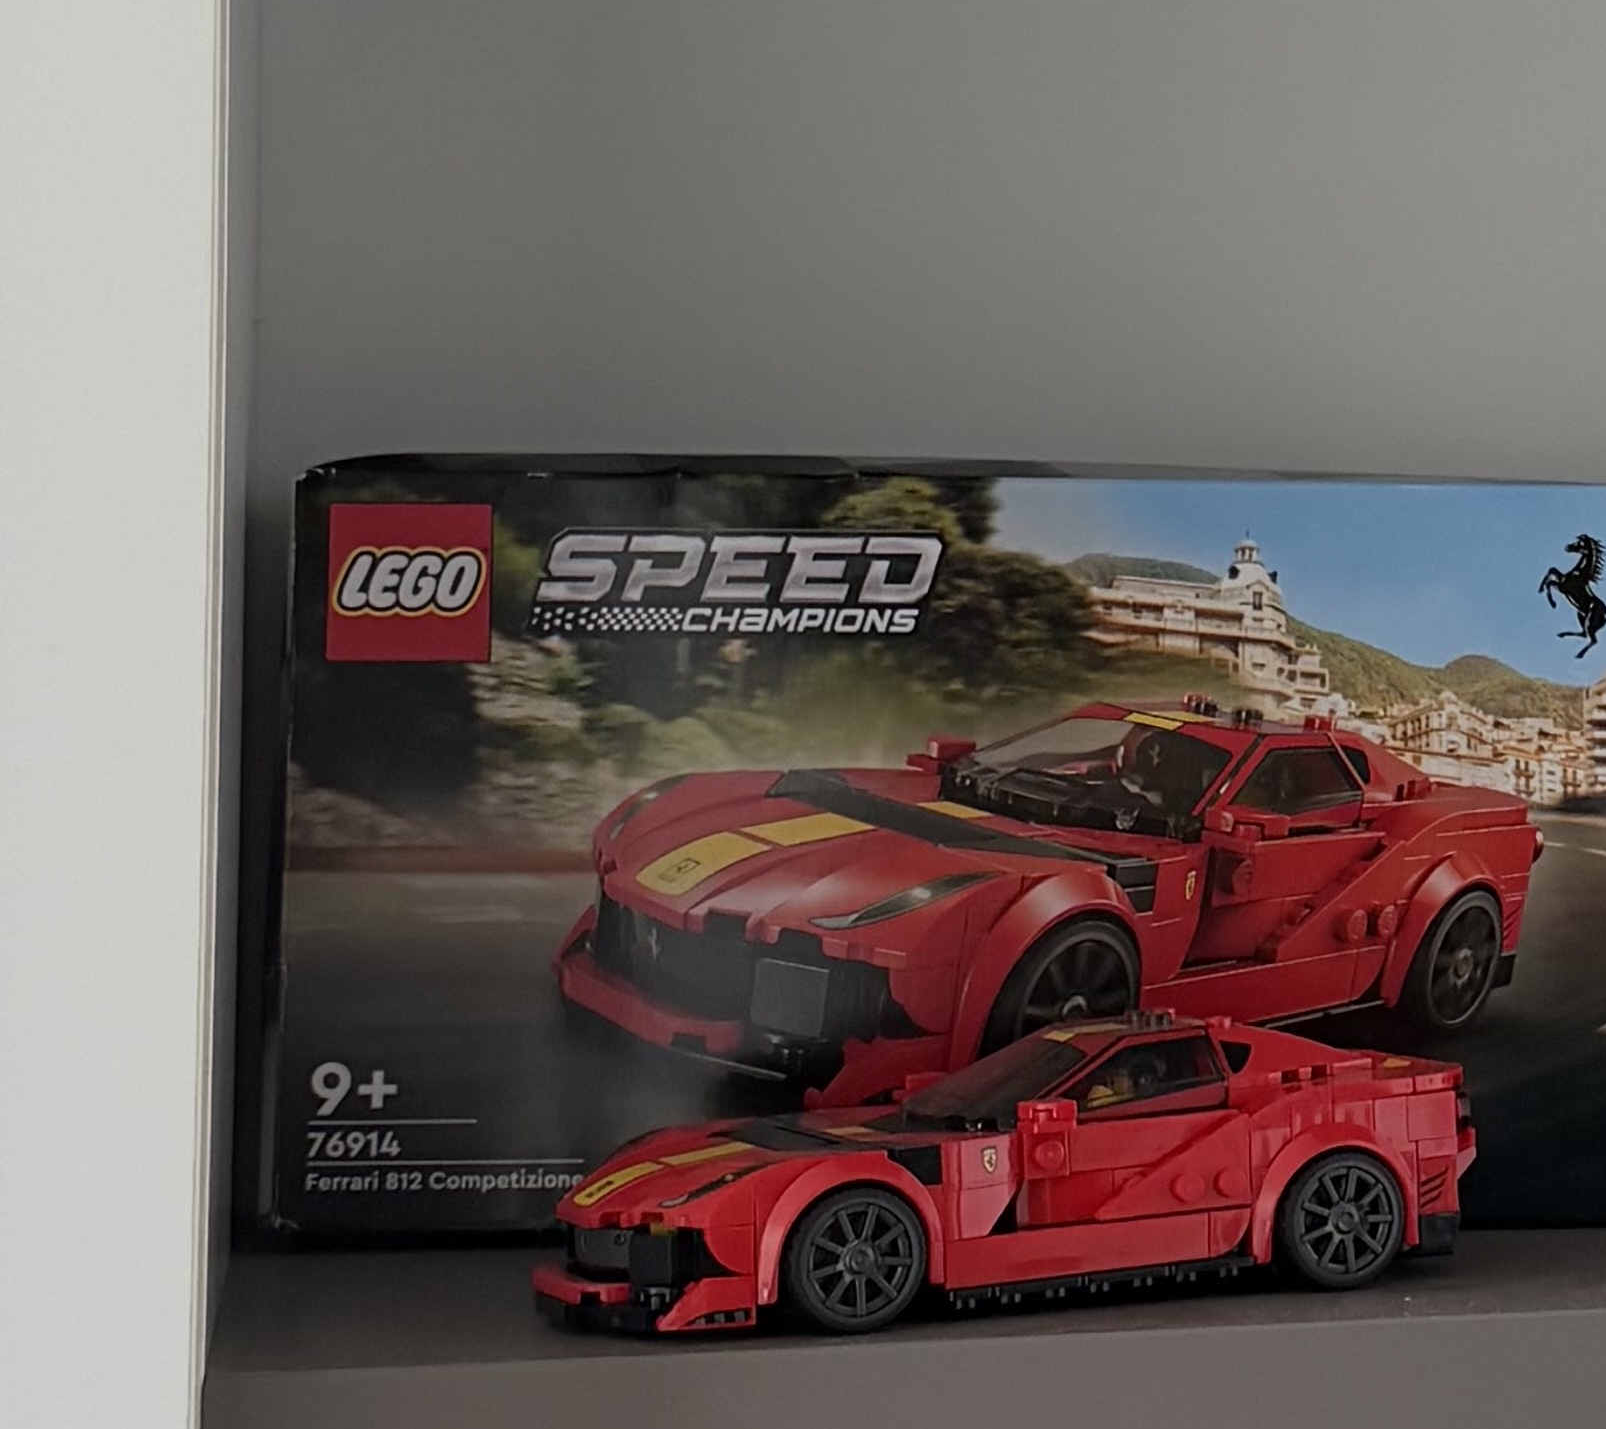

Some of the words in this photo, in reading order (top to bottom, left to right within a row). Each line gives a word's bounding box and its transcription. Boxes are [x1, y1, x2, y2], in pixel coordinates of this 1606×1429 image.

[336, 550, 485, 614] LEGO
[537, 534, 943, 604] SPEED
[311, 1061, 398, 1117] 9+
[306, 1130, 401, 1159] 76914
[305, 1170, 380, 1191] Ferrari
[385, 1171, 423, 1190] 812
[428, 1168, 584, 1193] Competizione
